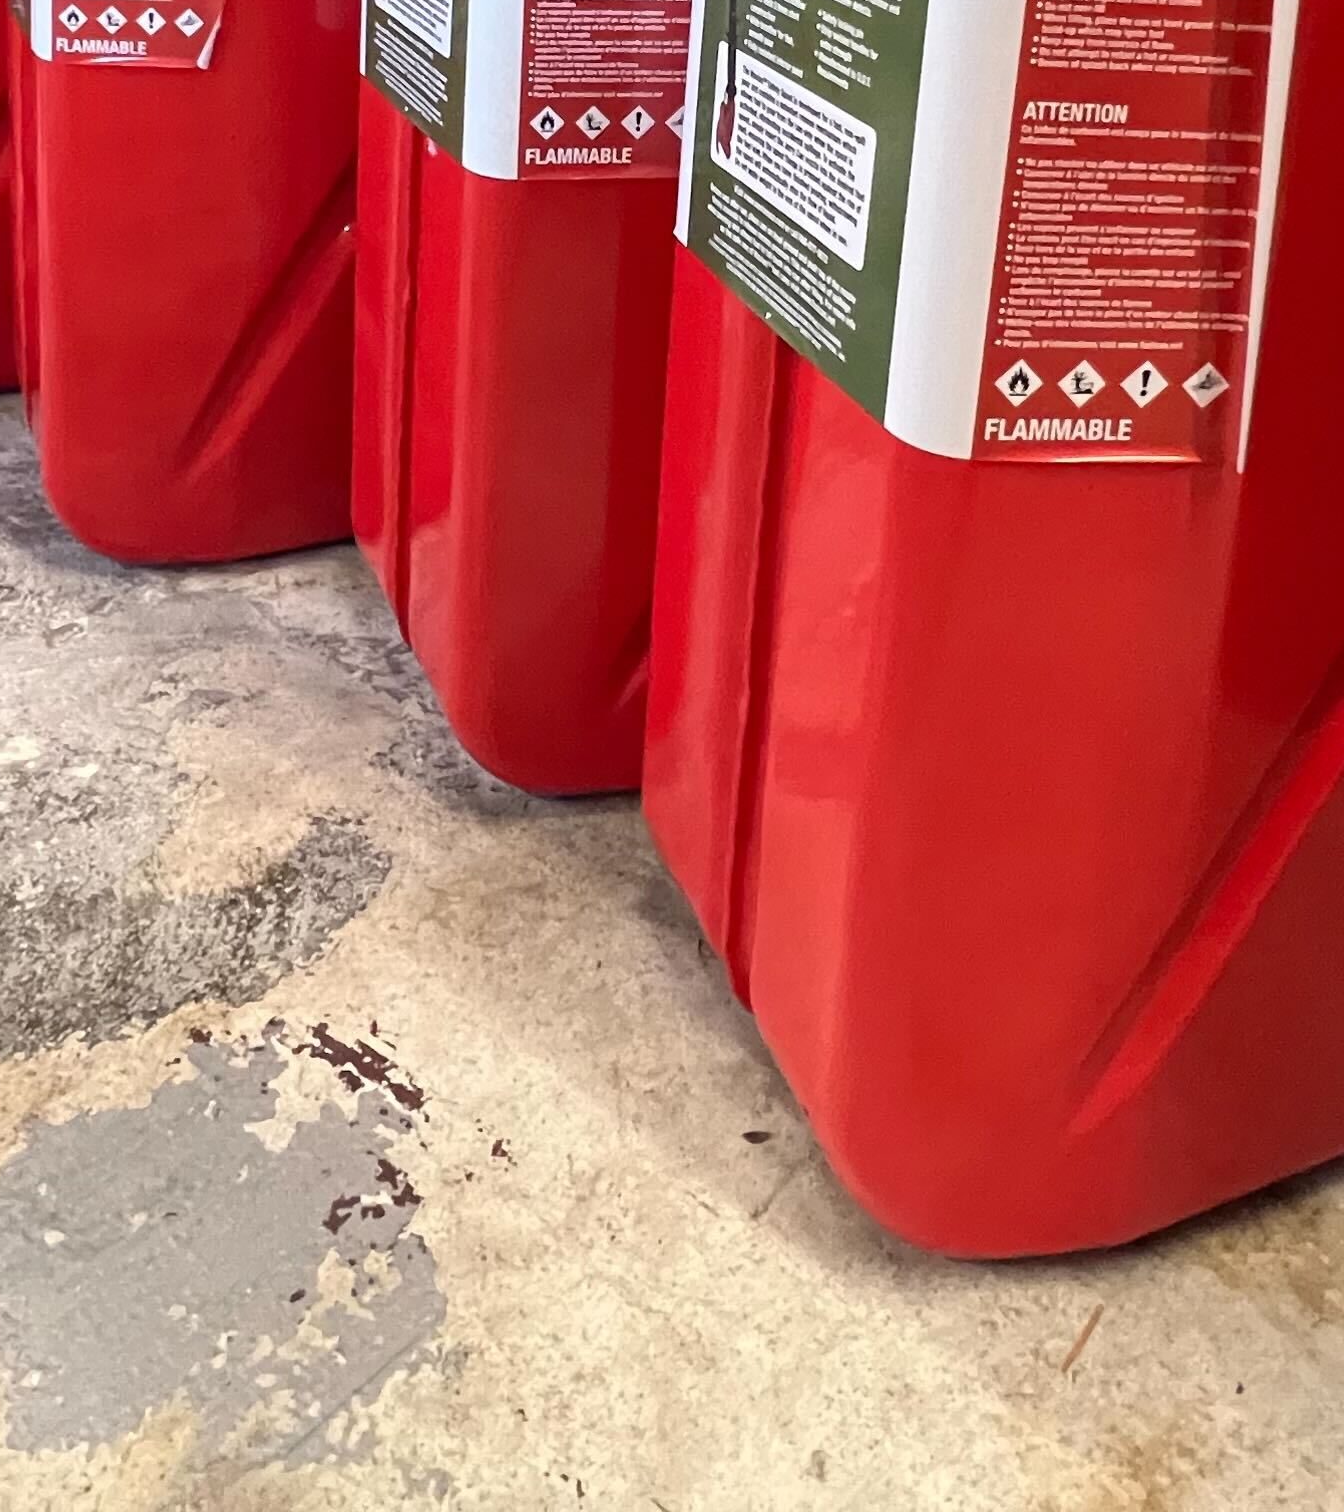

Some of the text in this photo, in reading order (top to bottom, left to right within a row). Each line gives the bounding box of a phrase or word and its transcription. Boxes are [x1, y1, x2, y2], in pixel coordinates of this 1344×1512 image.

[55, 37, 148, 56] FLAMMABLE
[1022, 101, 1129, 124] ATTENTION
[525, 147, 633, 166] FLAMMABLE
[984, 418, 1133, 442] FLAMMABLE
